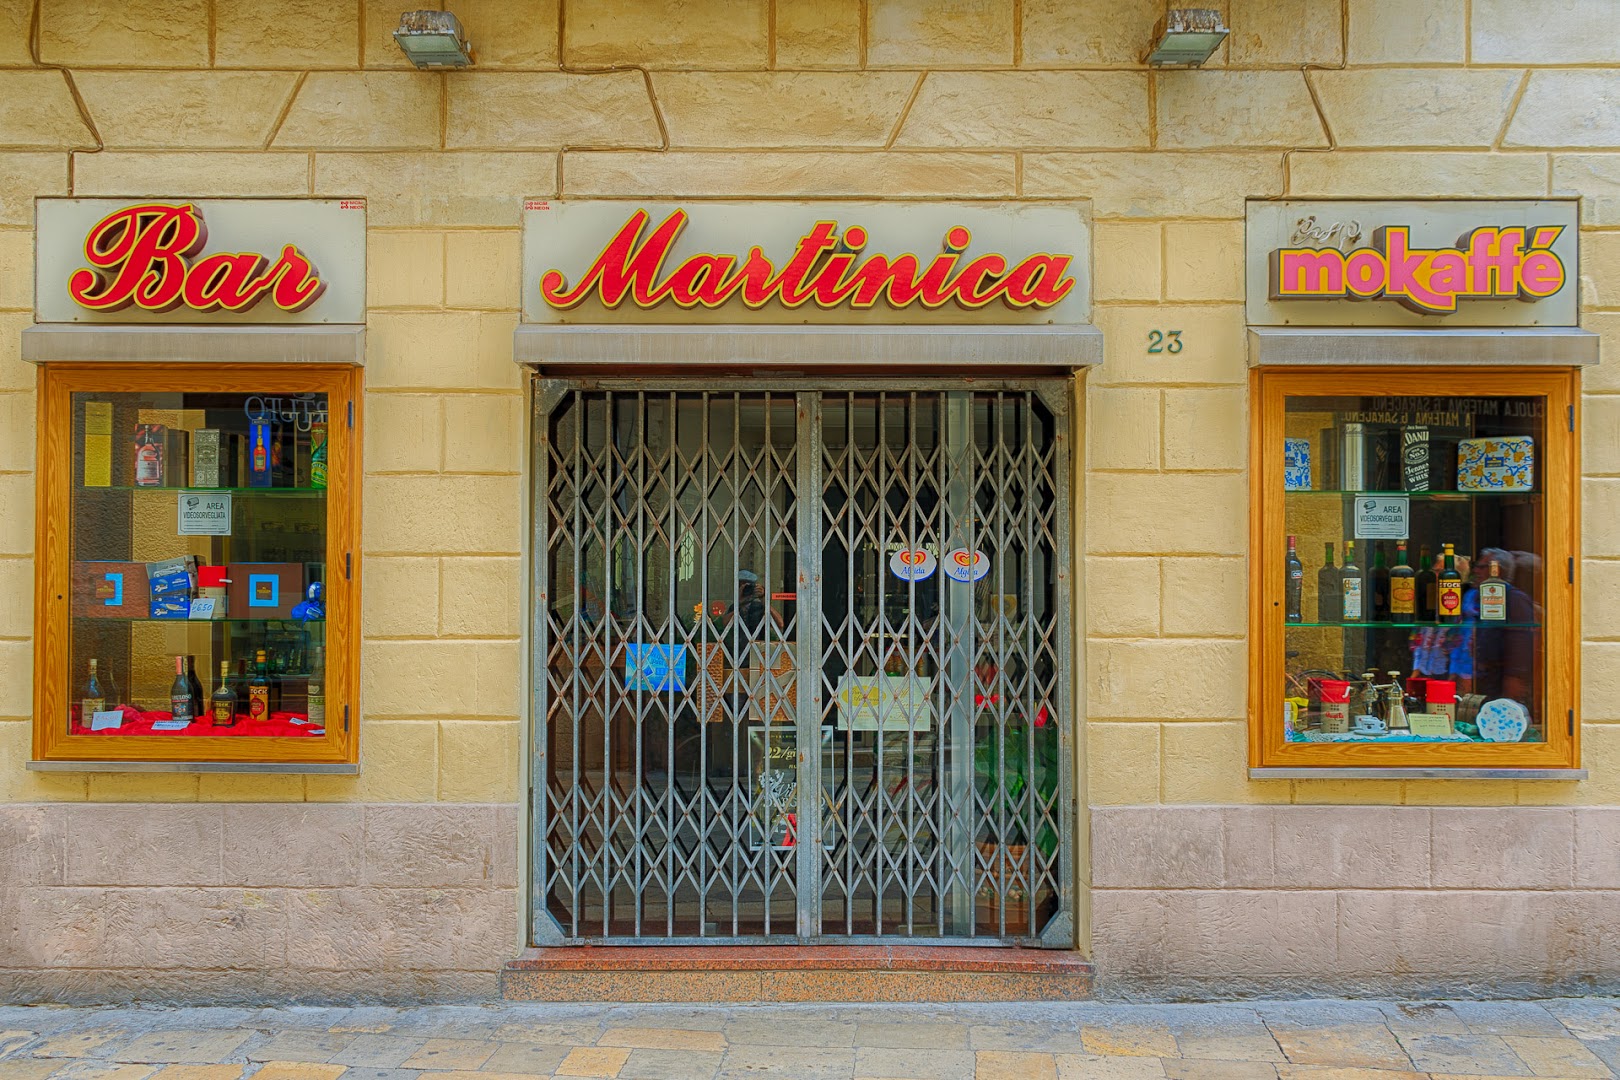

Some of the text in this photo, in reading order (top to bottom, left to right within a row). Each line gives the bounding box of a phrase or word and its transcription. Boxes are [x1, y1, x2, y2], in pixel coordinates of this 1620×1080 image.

[68, 203, 323, 311] Bar
[540, 207, 1076, 309] Martinica
[1275, 225, 1567, 312] mokaffé
[1148, 330, 1182, 353] 23
[954, 566, 979, 579] Alga
